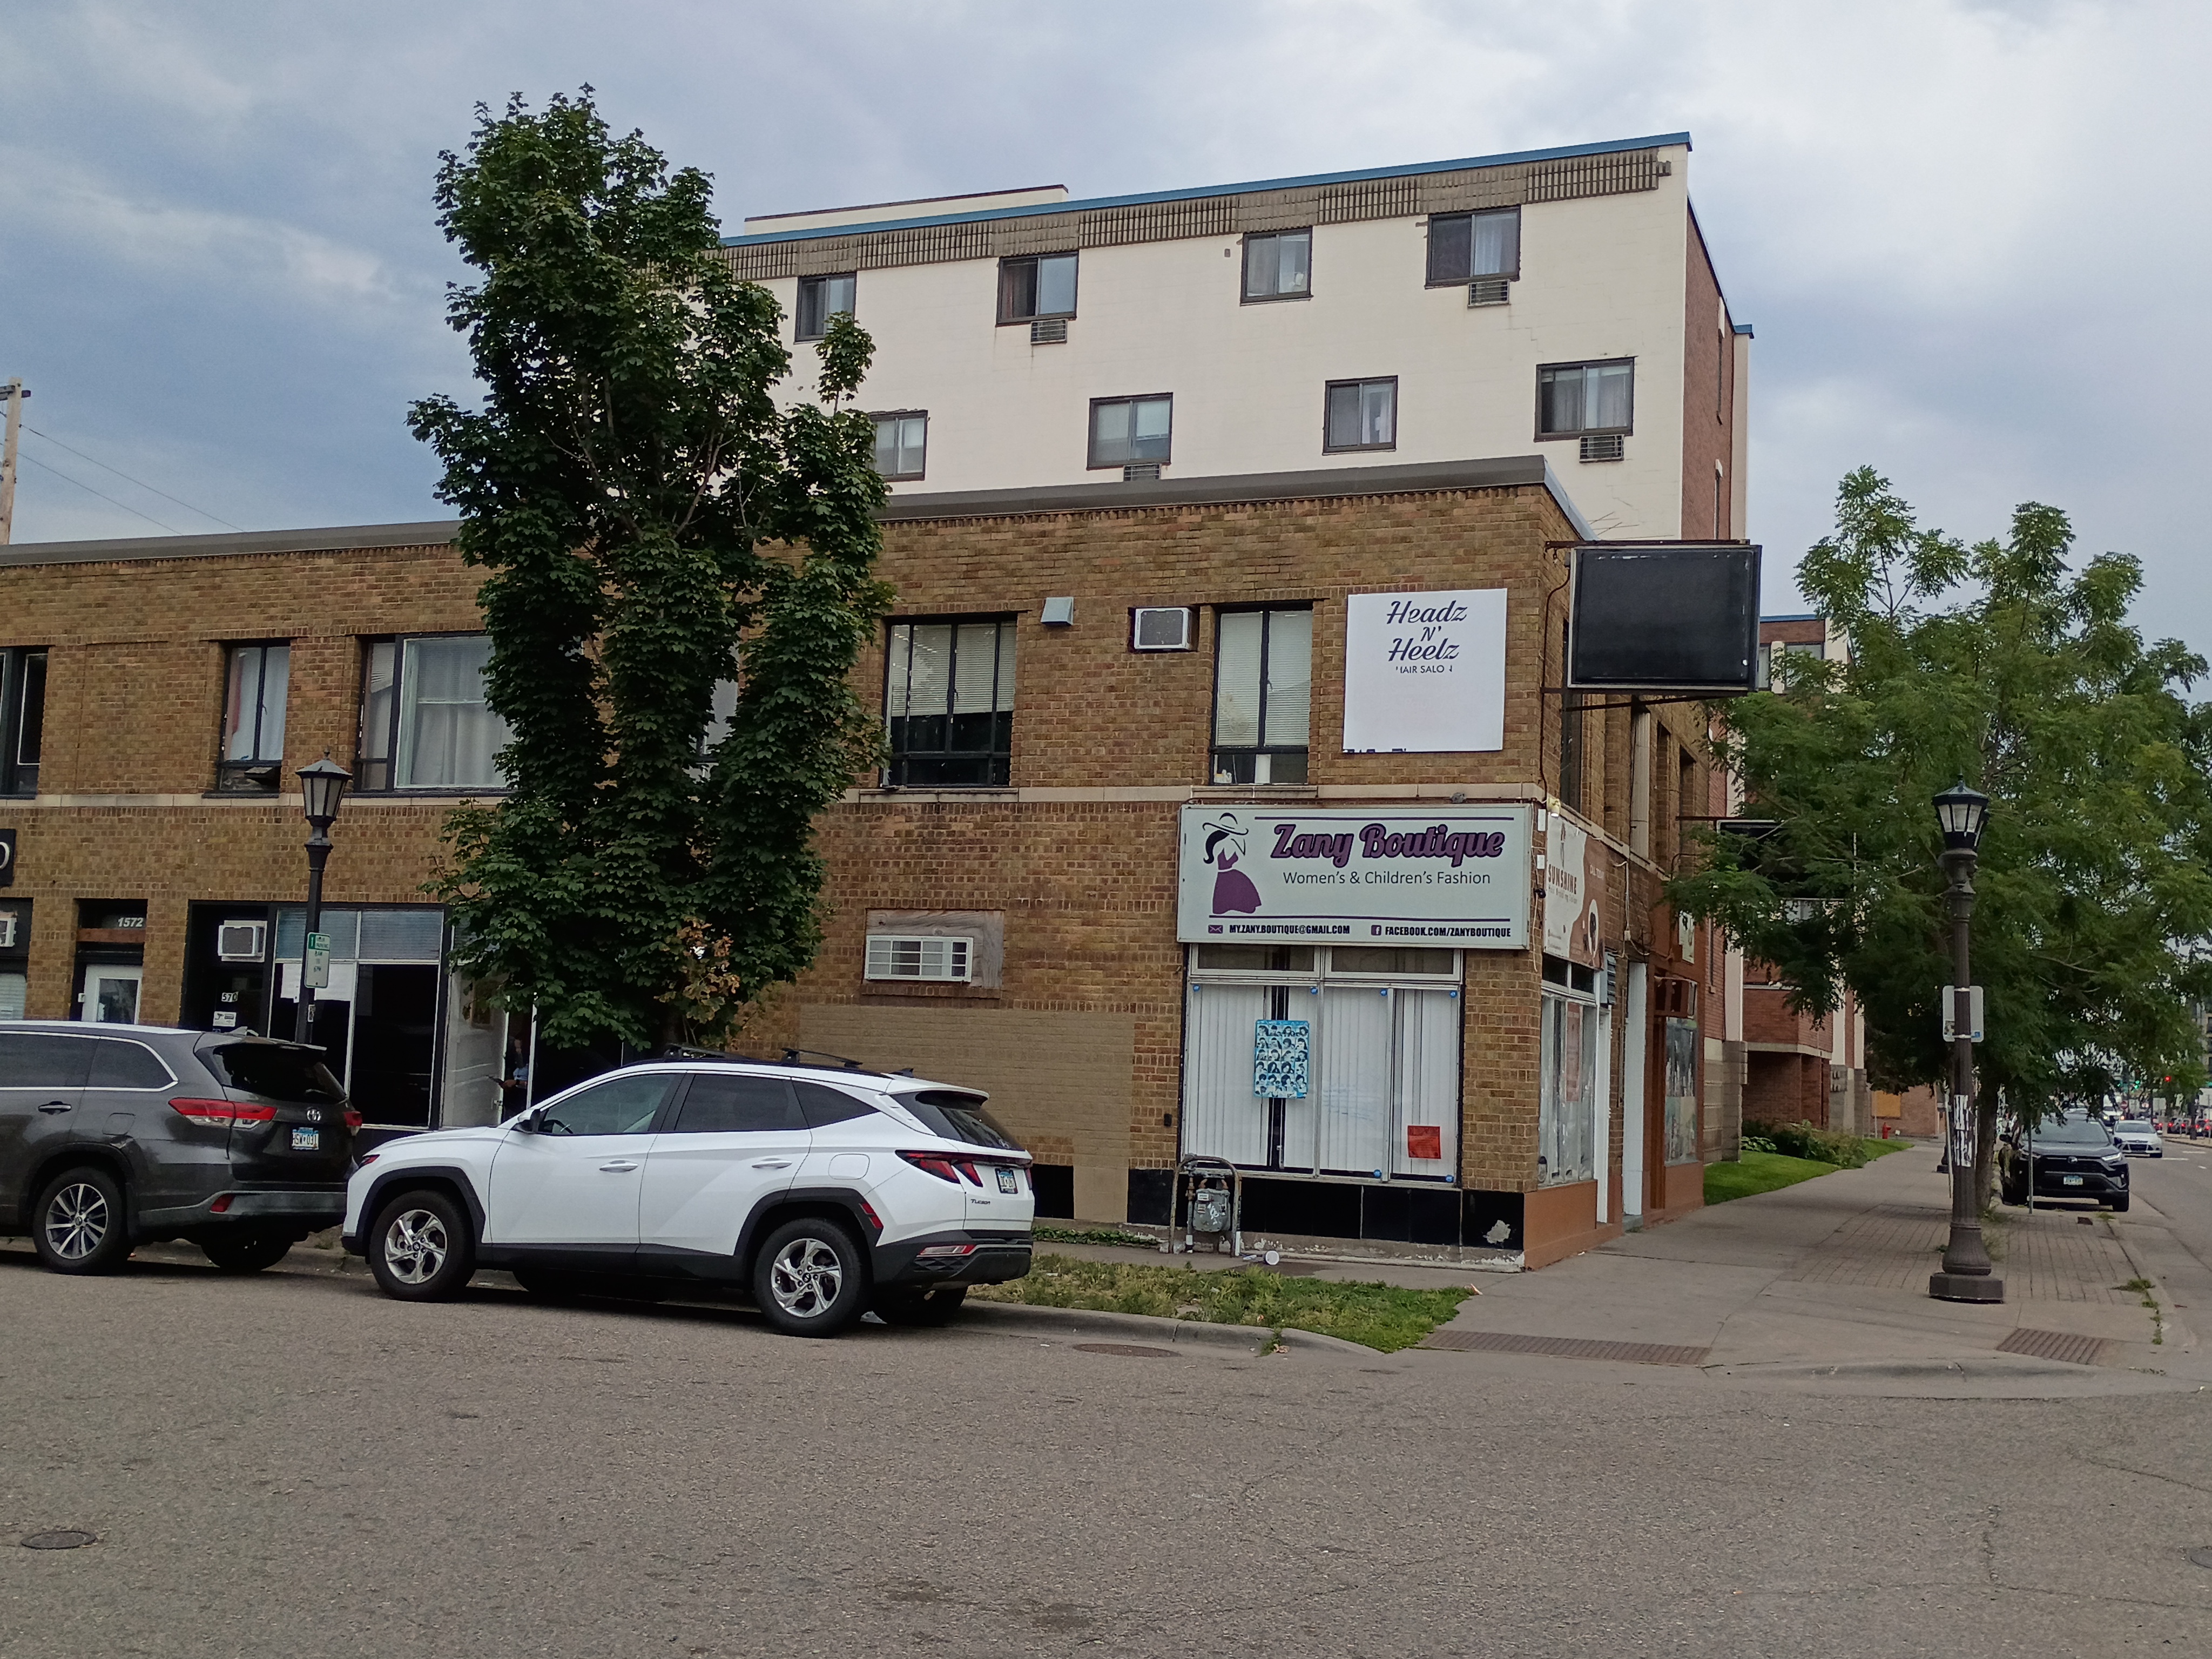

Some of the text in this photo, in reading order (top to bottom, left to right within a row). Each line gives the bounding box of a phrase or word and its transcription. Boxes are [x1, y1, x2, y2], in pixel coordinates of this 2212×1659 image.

[1387, 600, 1468, 624] Headz
[1388, 637, 1460, 662] Heelz
[1271, 822, 1505, 868] Zany Boutique
[1283, 871, 1491, 885] Women's & Children's Fashion
[1548, 864, 1577, 895] SUNSHINE
[118, 918, 144, 927] 1572
[1385, 926, 1511, 938] FACEBOOK.COM/ZANYBOUTIQUE
